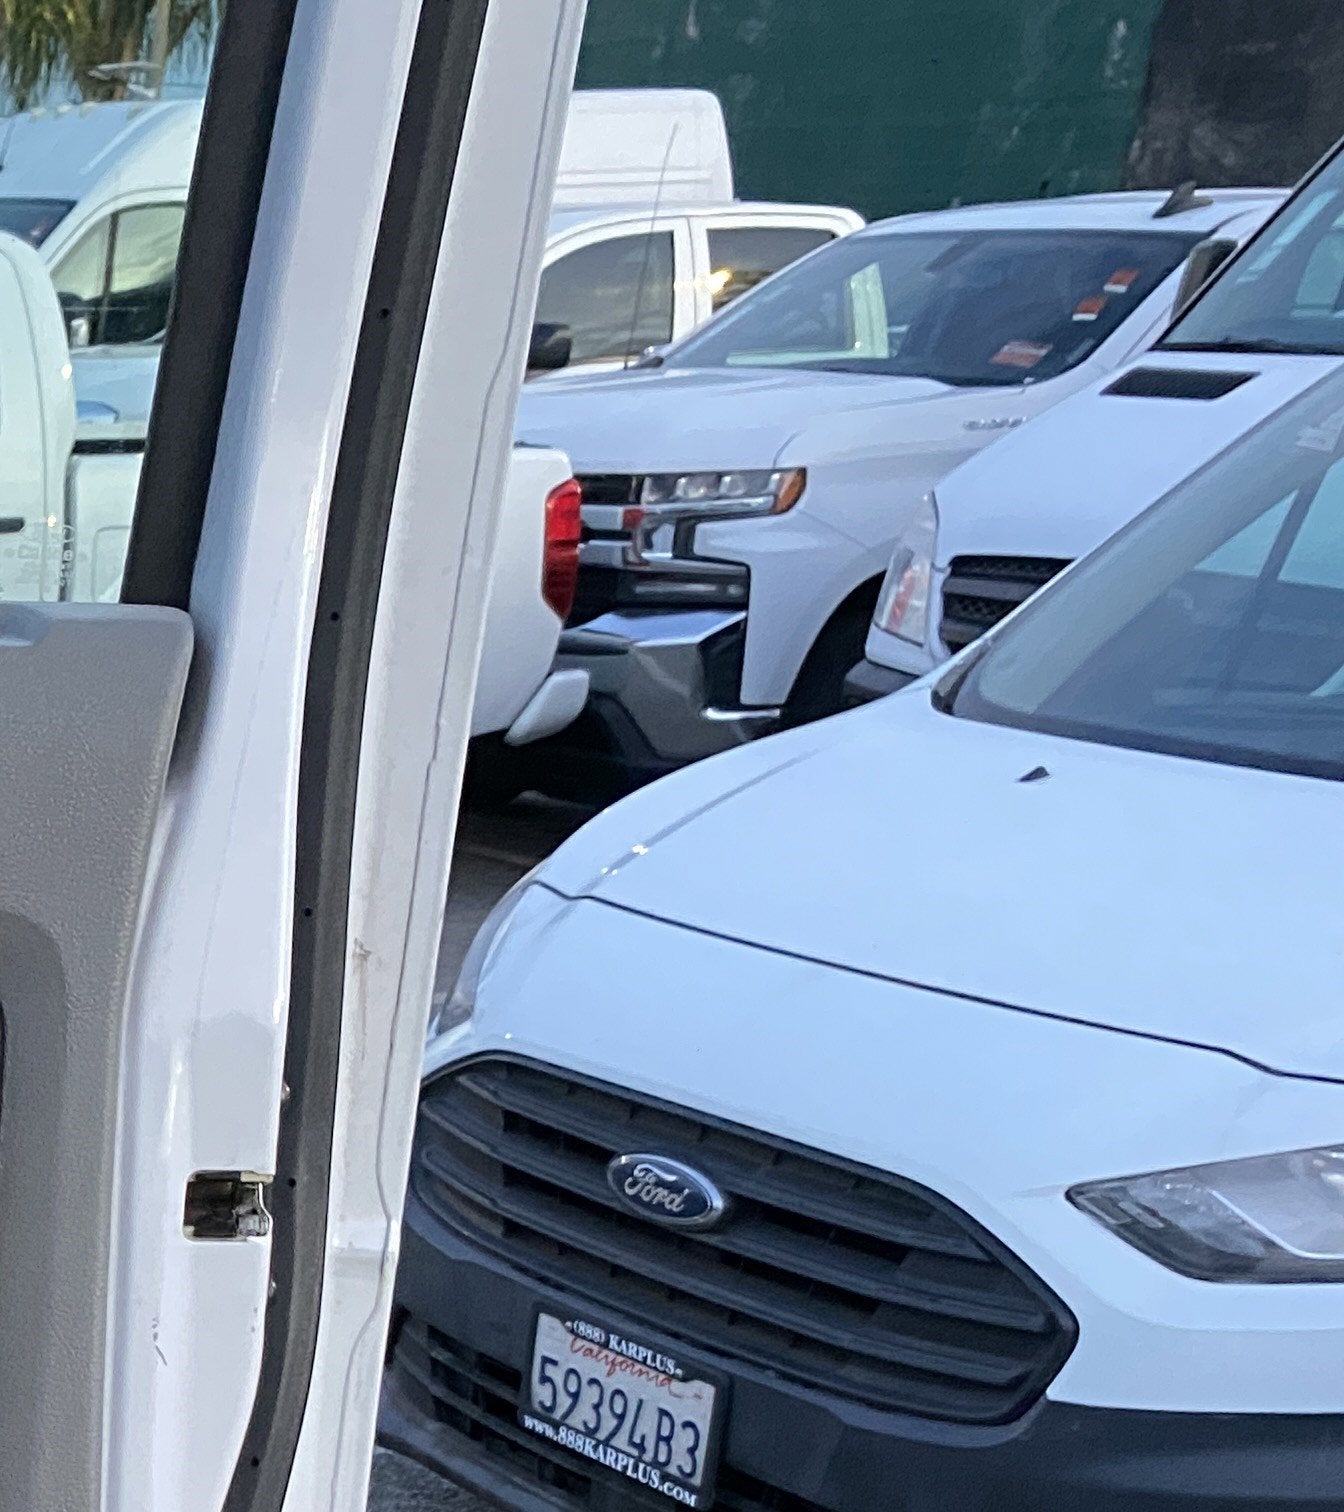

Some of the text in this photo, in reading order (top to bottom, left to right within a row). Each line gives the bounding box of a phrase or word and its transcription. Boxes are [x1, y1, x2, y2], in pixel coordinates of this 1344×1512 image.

[624, 1163, 689, 1213] Ford
[573, 1319, 676, 1376] (888) KARPLUS
[537, 1354, 701, 1479] 59394B3
